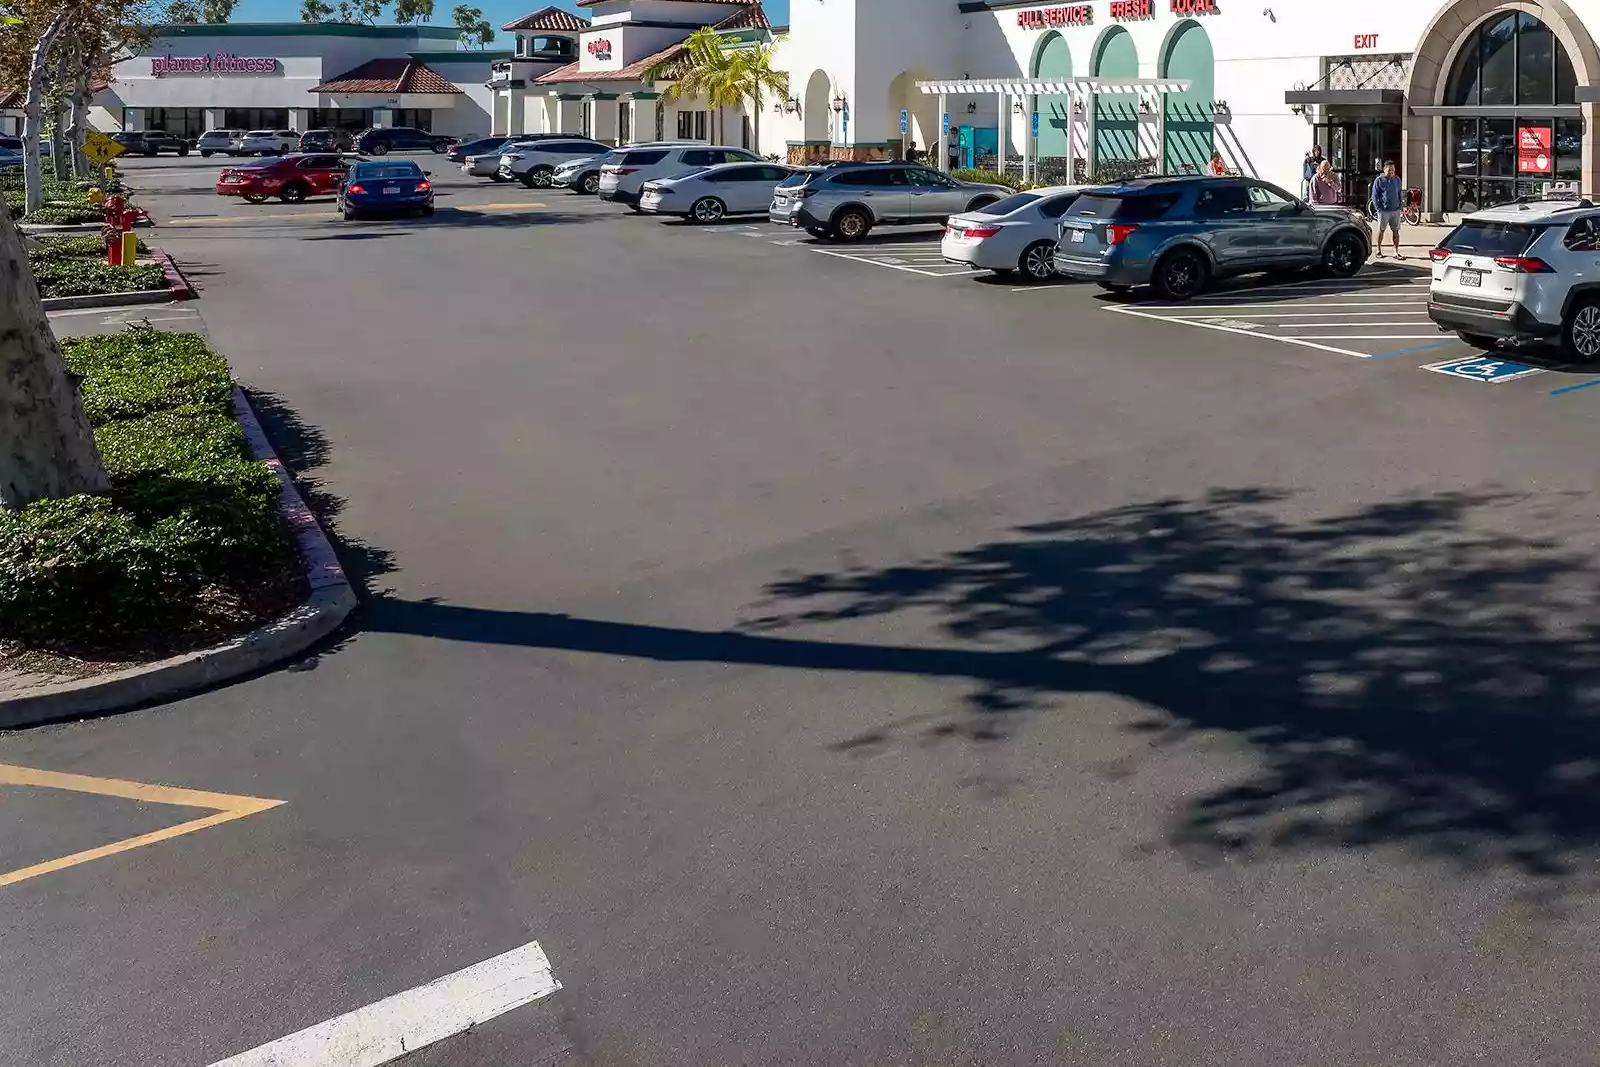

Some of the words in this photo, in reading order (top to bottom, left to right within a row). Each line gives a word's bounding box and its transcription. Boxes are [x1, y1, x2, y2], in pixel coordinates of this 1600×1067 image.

[1017, 8, 1042, 26] FULL
[1043, 5, 1088, 24] SERVICE
[1354, 33, 1379, 49] EXIT
[152, 53, 210, 78] planet
[211, 52, 276, 73] fitness
